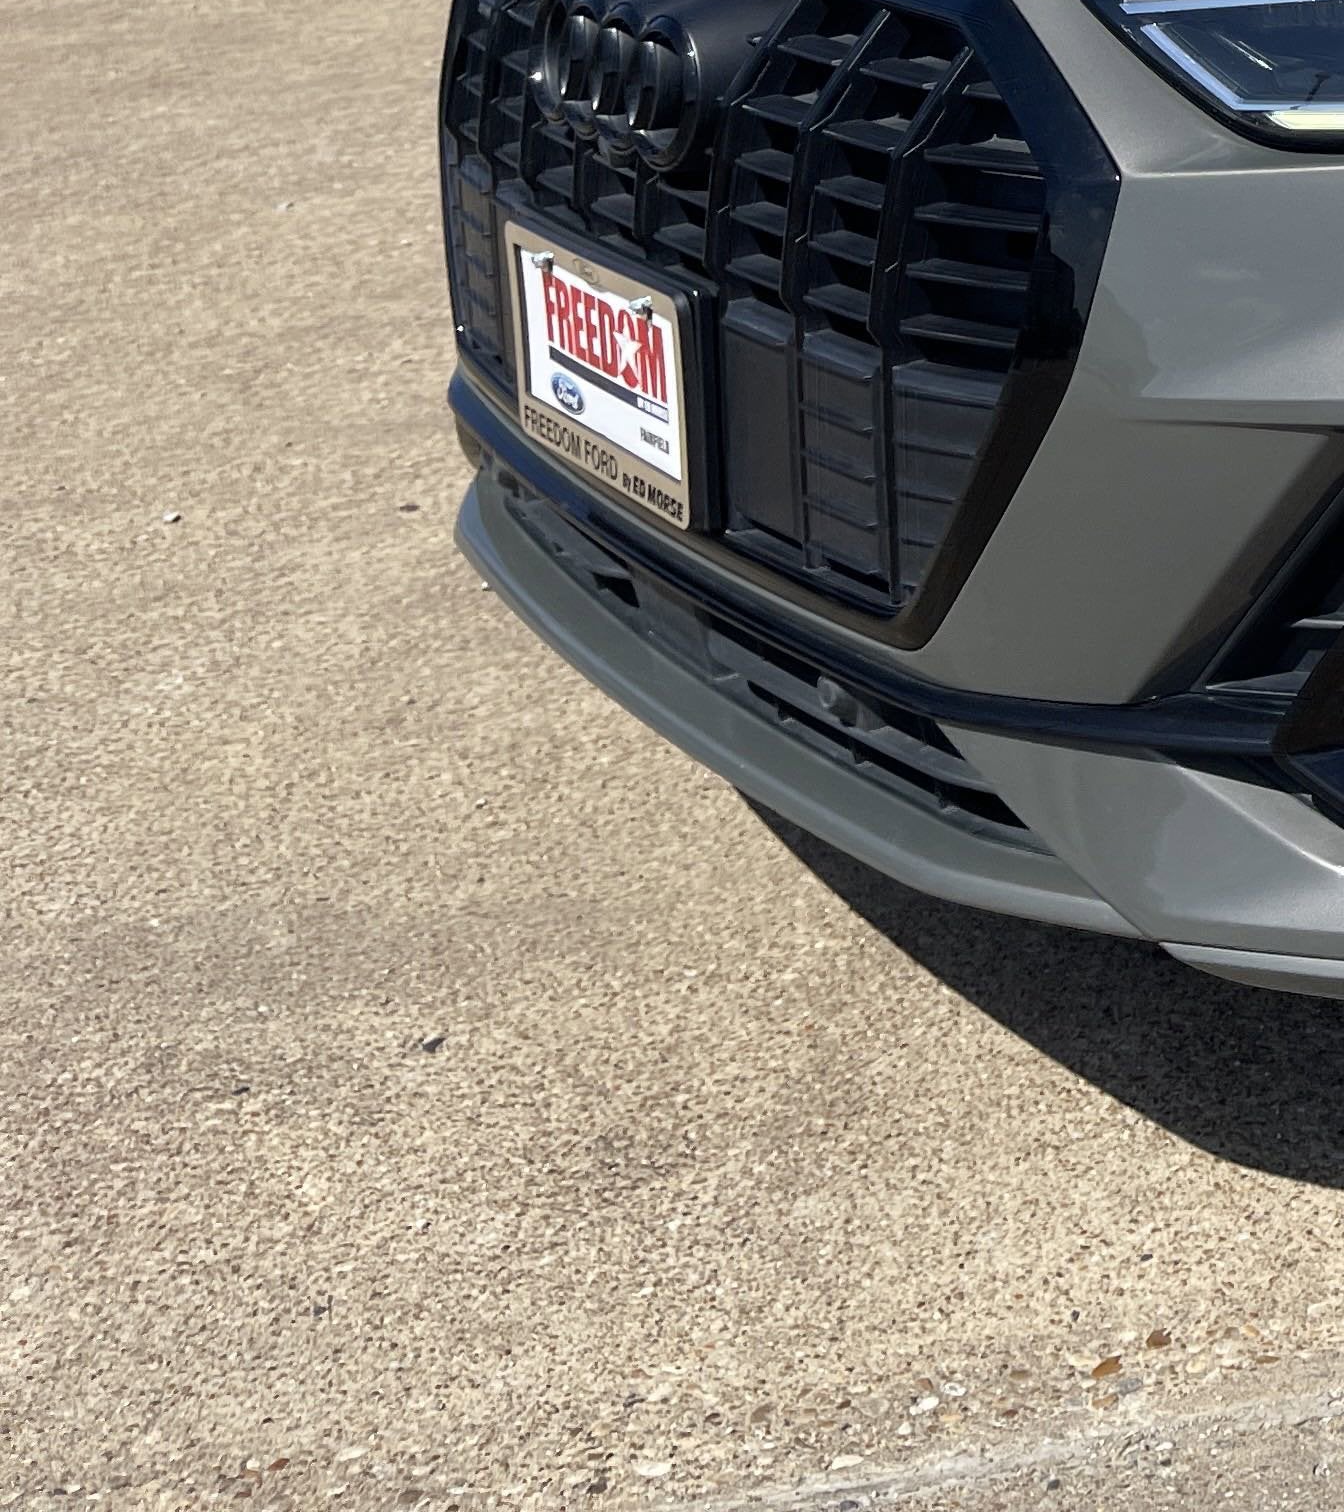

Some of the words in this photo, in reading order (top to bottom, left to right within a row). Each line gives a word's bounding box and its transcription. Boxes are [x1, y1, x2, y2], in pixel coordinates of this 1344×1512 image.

[541, 269, 668, 403] FREEDOM
[523, 405, 582, 461] FREEDOM
[584, 438, 619, 481] FORD
[633, 474, 646, 499] ED
[647, 483, 684, 522] MORSE
